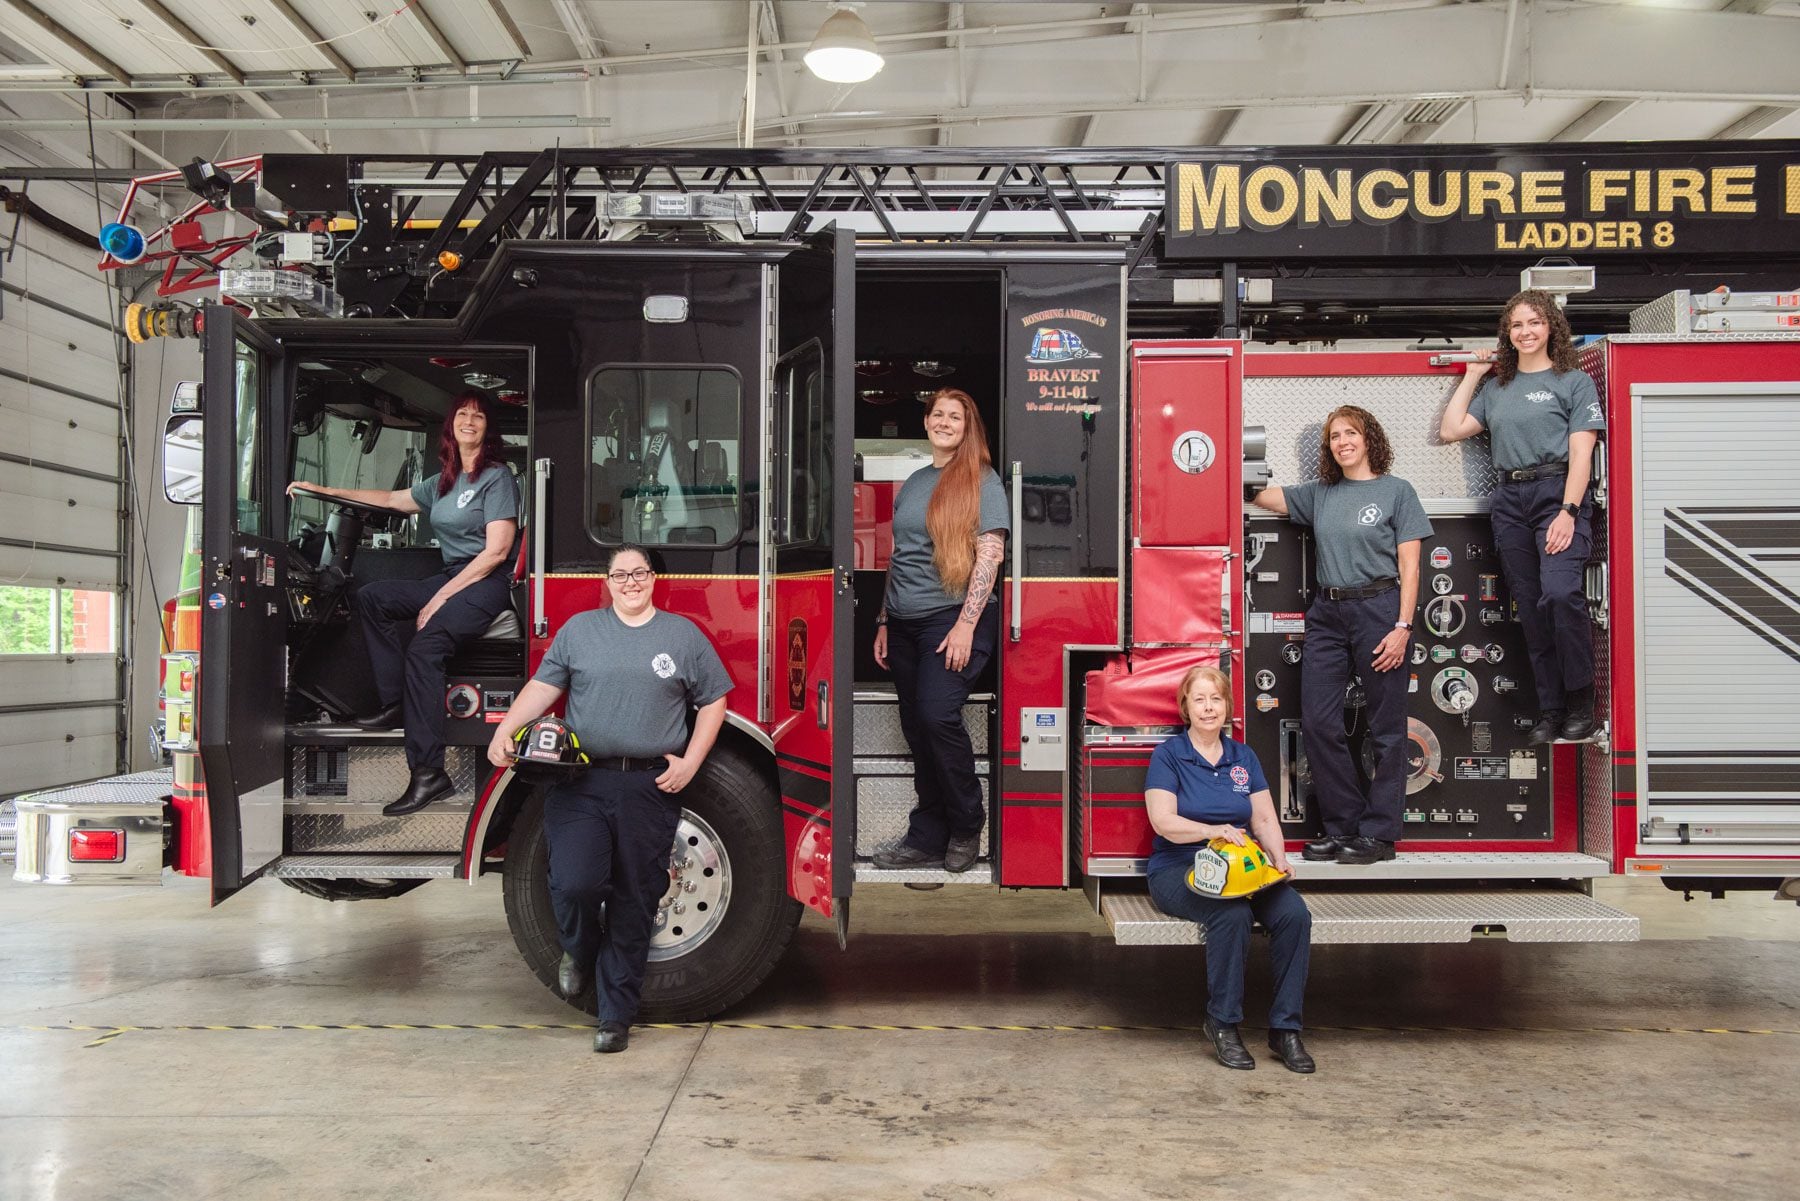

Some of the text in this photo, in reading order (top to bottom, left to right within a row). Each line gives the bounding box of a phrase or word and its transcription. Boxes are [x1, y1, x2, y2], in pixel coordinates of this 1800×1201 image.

[1175, 162, 1565, 233] MONCURE
[1586, 165, 1757, 213] FIRE
[1497, 221, 1675, 249] LADDER 8
[1021, 308, 1107, 327] HONORING AMERICA'S
[1027, 369, 1100, 382] BRAVEST
[1039, 385, 1088, 399] 9-11-01
[1025, 402, 1038, 412] We
[1039, 402, 1053, 412] will
[1054, 403, 1065, 412] not
[1361, 508, 1377, 523] 8
[539, 731, 557, 750] 8
[1198, 852, 1223, 867] MONCURE
